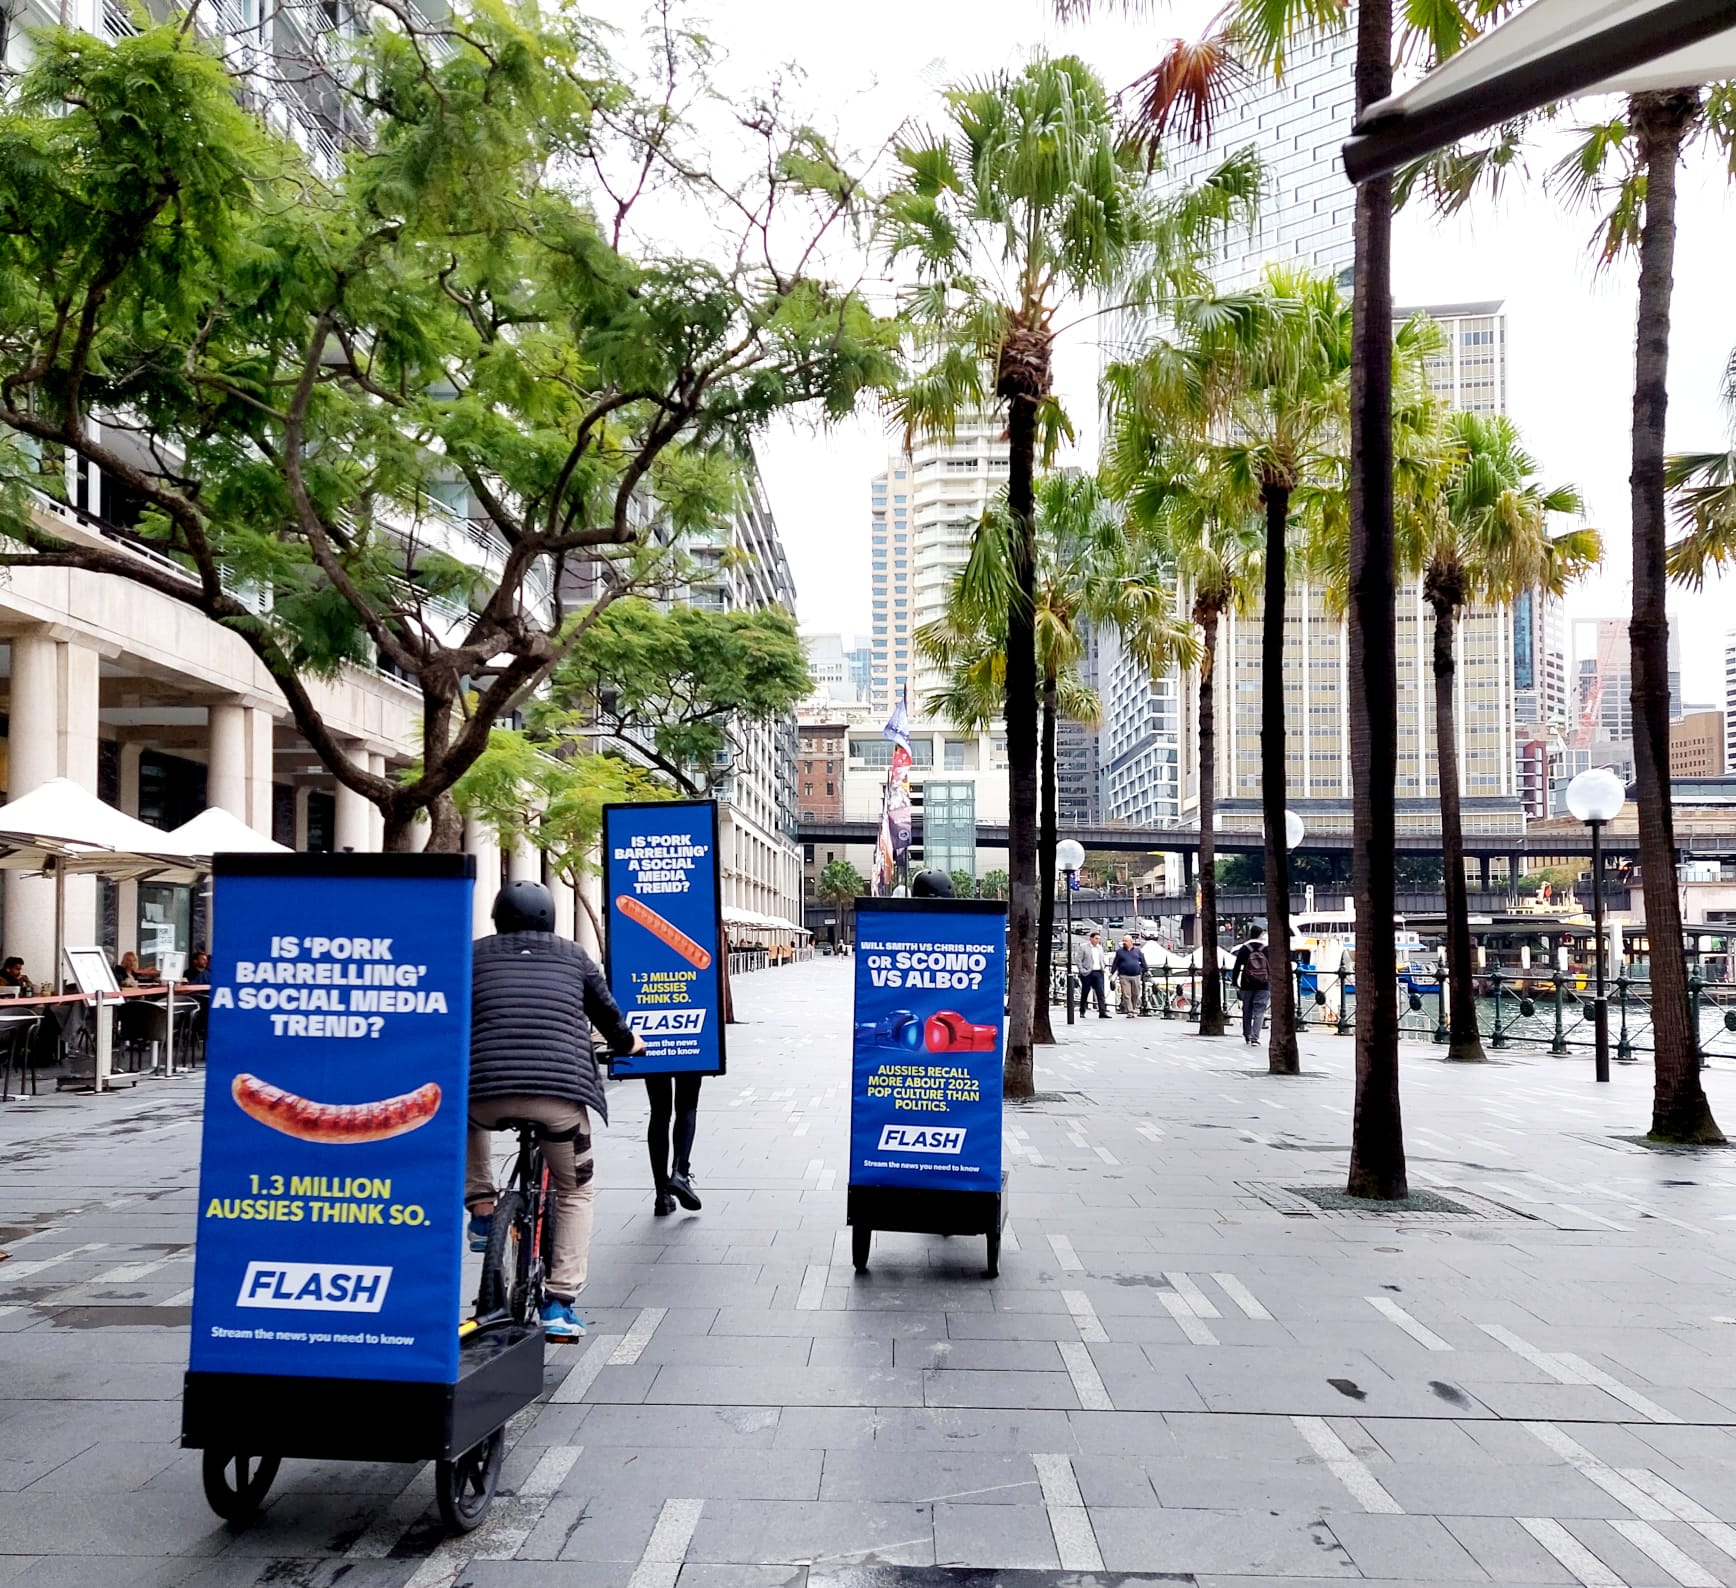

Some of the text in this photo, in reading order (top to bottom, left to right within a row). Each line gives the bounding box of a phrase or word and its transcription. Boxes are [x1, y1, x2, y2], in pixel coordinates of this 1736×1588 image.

[631, 836, 646, 847] IS
[628, 858, 695, 871] A SOCIAL
[638, 870, 686, 882] MEDIA
[633, 881, 690, 894] TREND?
[271, 936, 299, 958] IS
[861, 942, 884, 950] WILL
[886, 942, 918, 951] SMITH
[934, 944, 964, 952] CHRIS
[966, 945, 995, 953] ROCK
[868, 952, 987, 971] OR SCOMO
[632, 971, 696, 982] 1.3 MILLION
[871, 970, 982, 990] VS ALBO?
[641, 983, 686, 993] AUSSIES
[212, 987, 448, 1014] A SOCIAL MEDIA
[636, 993, 691, 1004] THINK SO.
[270, 1015, 385, 1038] TREND?
[630, 1014, 700, 1030] FLASH
[646, 1048, 666, 1056] need
[878, 1065, 970, 1078] AUSSIES RECALL
[868, 1076, 979, 1090] MORE ABOUT 2022
[868, 1087, 980, 1101] POP CULTURE THAN
[895, 1100, 950, 1111] POLITICS.
[884, 1130, 960, 1148] FLASH
[250, 1174, 391, 1199] 1.3 MILLION
[206, 1199, 431, 1226] AUSSIES THINK SO.
[249, 1271, 381, 1303] FLASH
[211, 1327, 414, 1345] Stream the news you need to know
